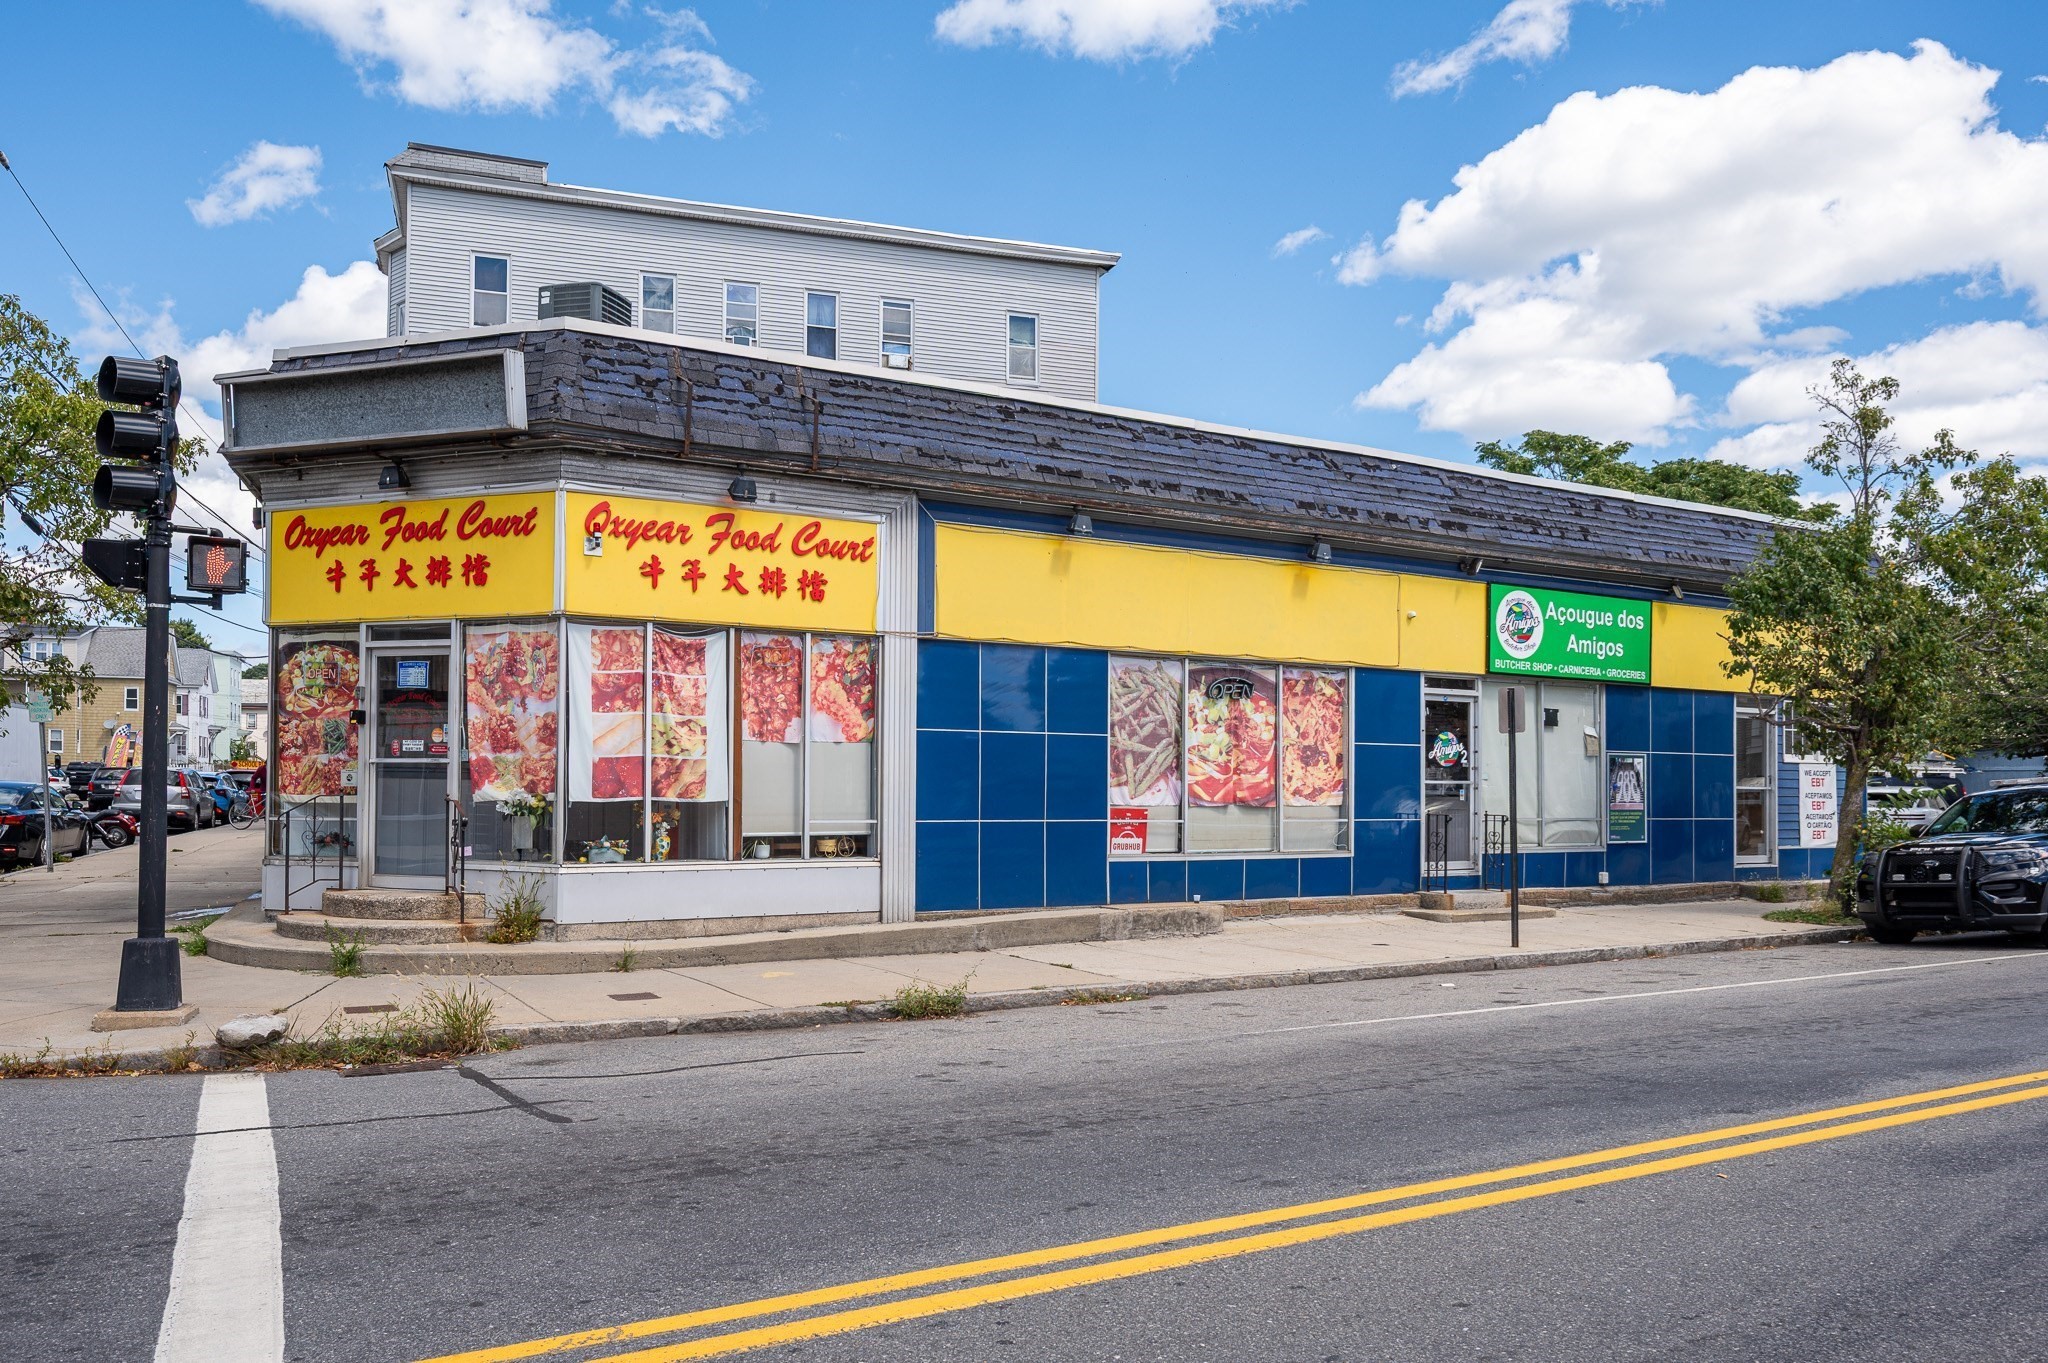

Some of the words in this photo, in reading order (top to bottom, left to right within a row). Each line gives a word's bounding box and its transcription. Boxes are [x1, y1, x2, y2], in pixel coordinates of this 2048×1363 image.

[284, 515, 370, 558] Oxyear
[380, 506, 449, 551] Food
[456, 500, 538, 540] Court
[584, 501, 693, 550] Oxyear
[705, 512, 783, 554] Food
[791, 521, 875, 562] Court
[326, 553, 491, 593] 牛年大排檔
[639, 554, 828, 602] 牛年大排檔
[1500, 613, 1540, 634] Amigos
[1545, 601, 1613, 629] Açougue
[1617, 610, 1644, 630] dos
[1566, 634, 1624, 660] Amigos
[308, 668, 336, 679] OPEN
[1495, 659, 1531, 670] BUTCHER
[1532, 662, 1553, 672] SHOP
[1558, 665, 1601, 676] CARNICERIA
[1606, 669, 1646, 680] GROCERIES
[1211, 684, 1254, 699] OPEN
[1428, 742, 1464, 759] Amigos
[1460, 750, 1468, 763] 2
[1811, 778, 1825, 787] EBT
[1811, 801, 1826, 810] EBT
[1812, 830, 1826, 839] EBT
